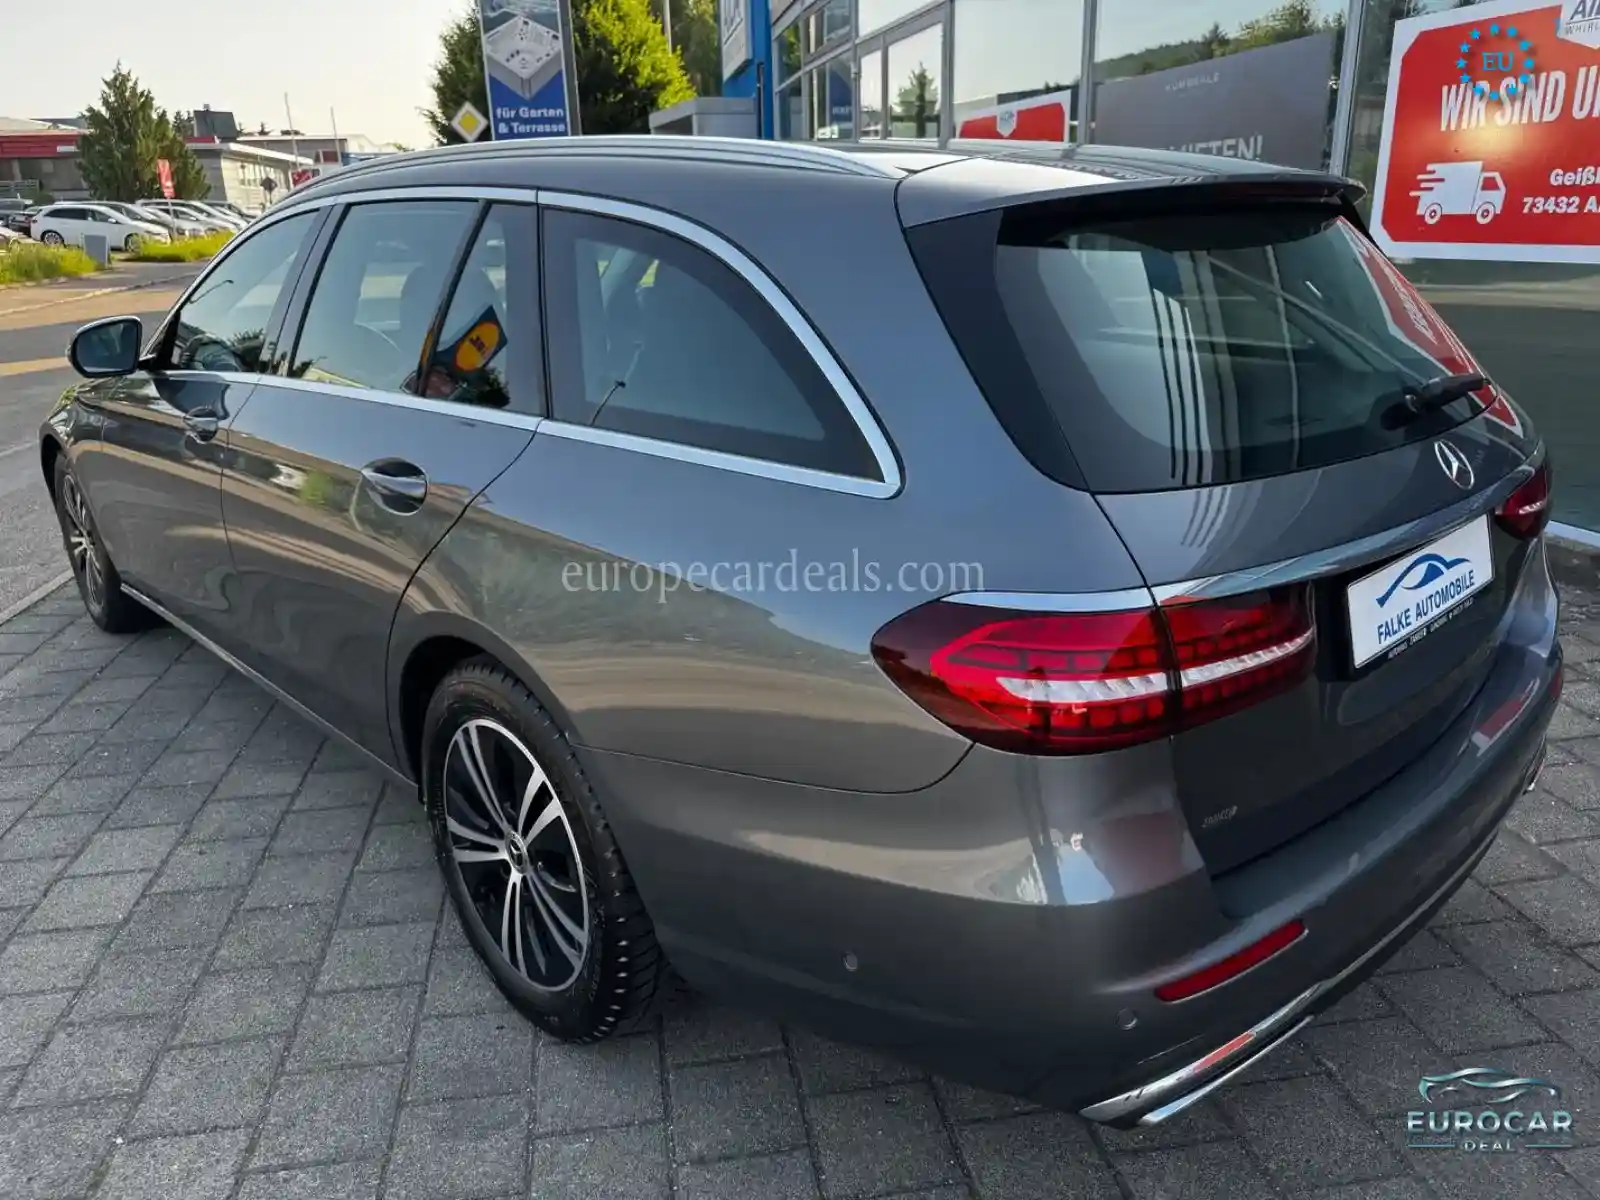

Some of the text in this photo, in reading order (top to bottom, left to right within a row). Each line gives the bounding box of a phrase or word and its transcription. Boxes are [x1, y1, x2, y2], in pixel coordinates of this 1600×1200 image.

[1440, 80, 1490, 131] WIR
[1494, 71, 1566, 127] SIND
[496, 107, 564, 119] für Garten
[510, 121, 566, 134] Terrasse
[1522, 196, 1580, 214] 73432
[1377, 608, 1412, 645] FALKE
[1415, 570, 1476, 622] AUTOMOBILE
